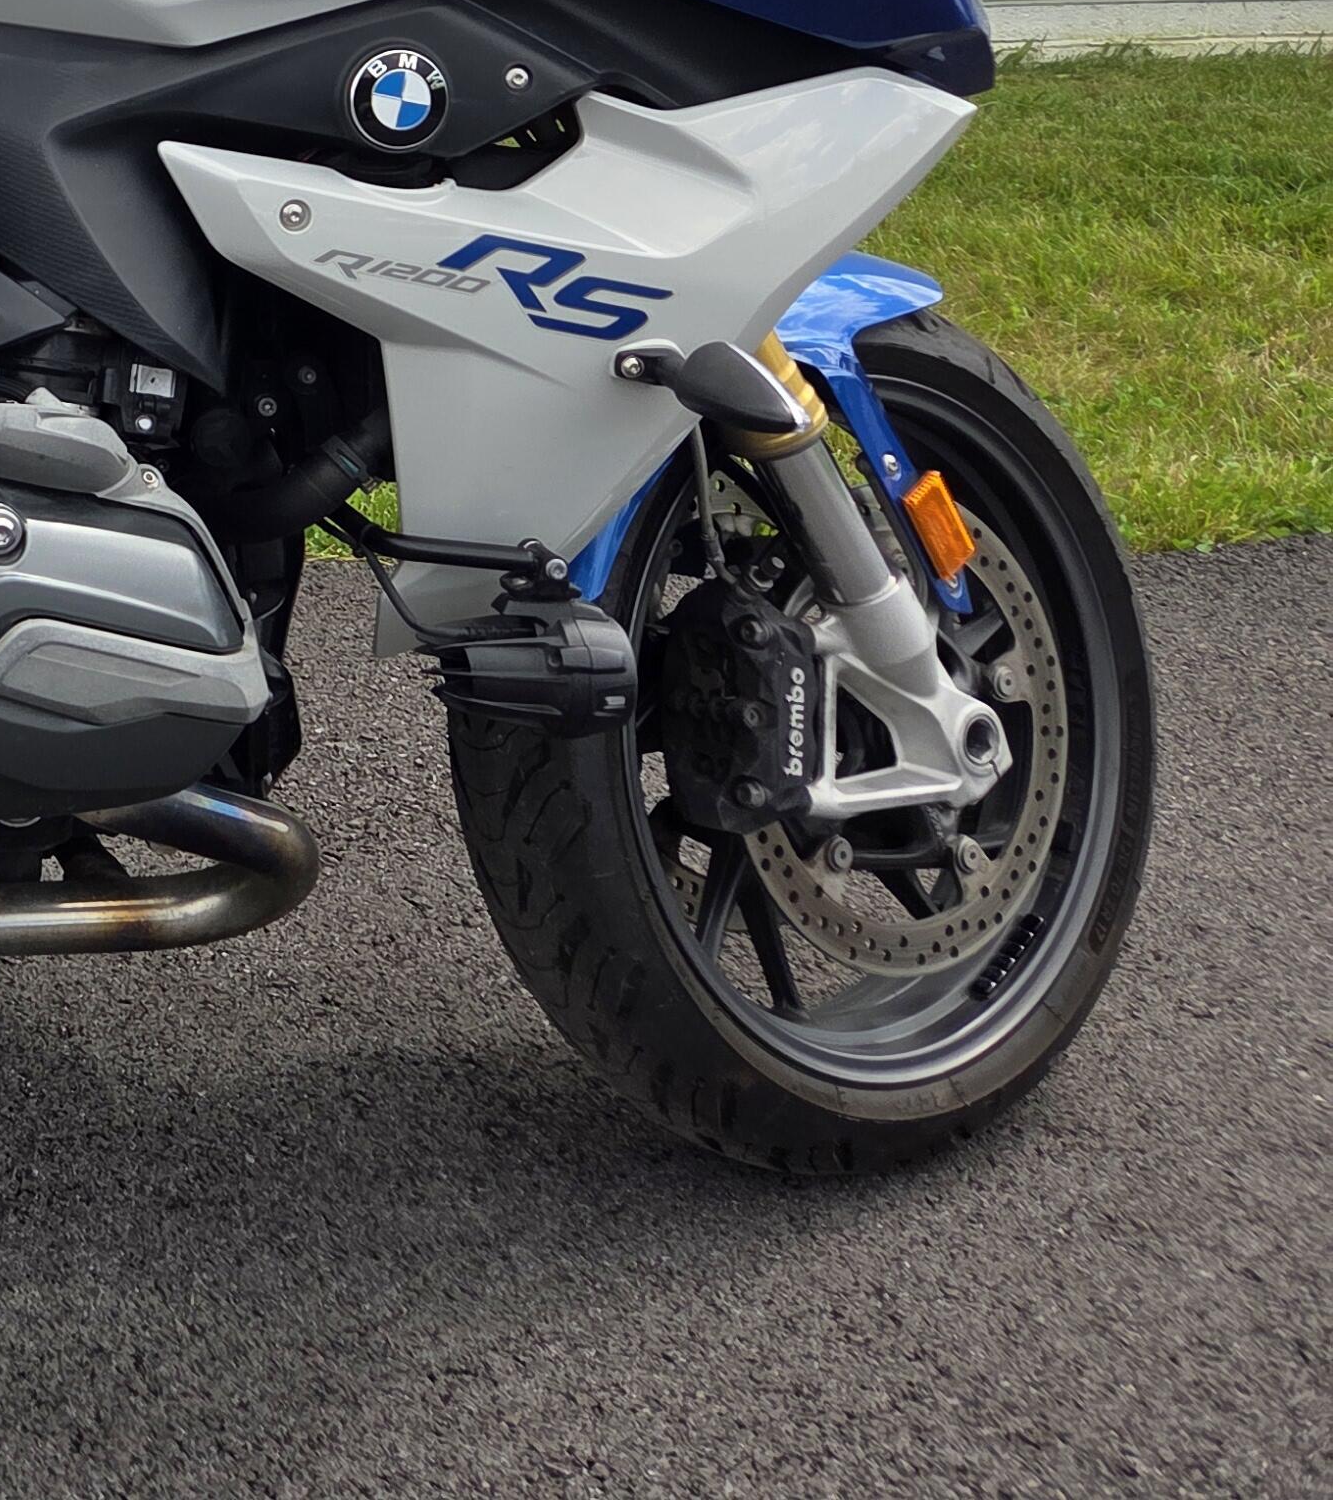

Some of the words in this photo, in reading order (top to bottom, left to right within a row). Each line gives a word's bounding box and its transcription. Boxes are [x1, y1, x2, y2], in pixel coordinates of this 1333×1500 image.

[367, 53, 445, 90] BMW
[314, 249, 491, 294] R1200
[436, 234, 674, 341] RS
[783, 666, 806, 777] brembo
